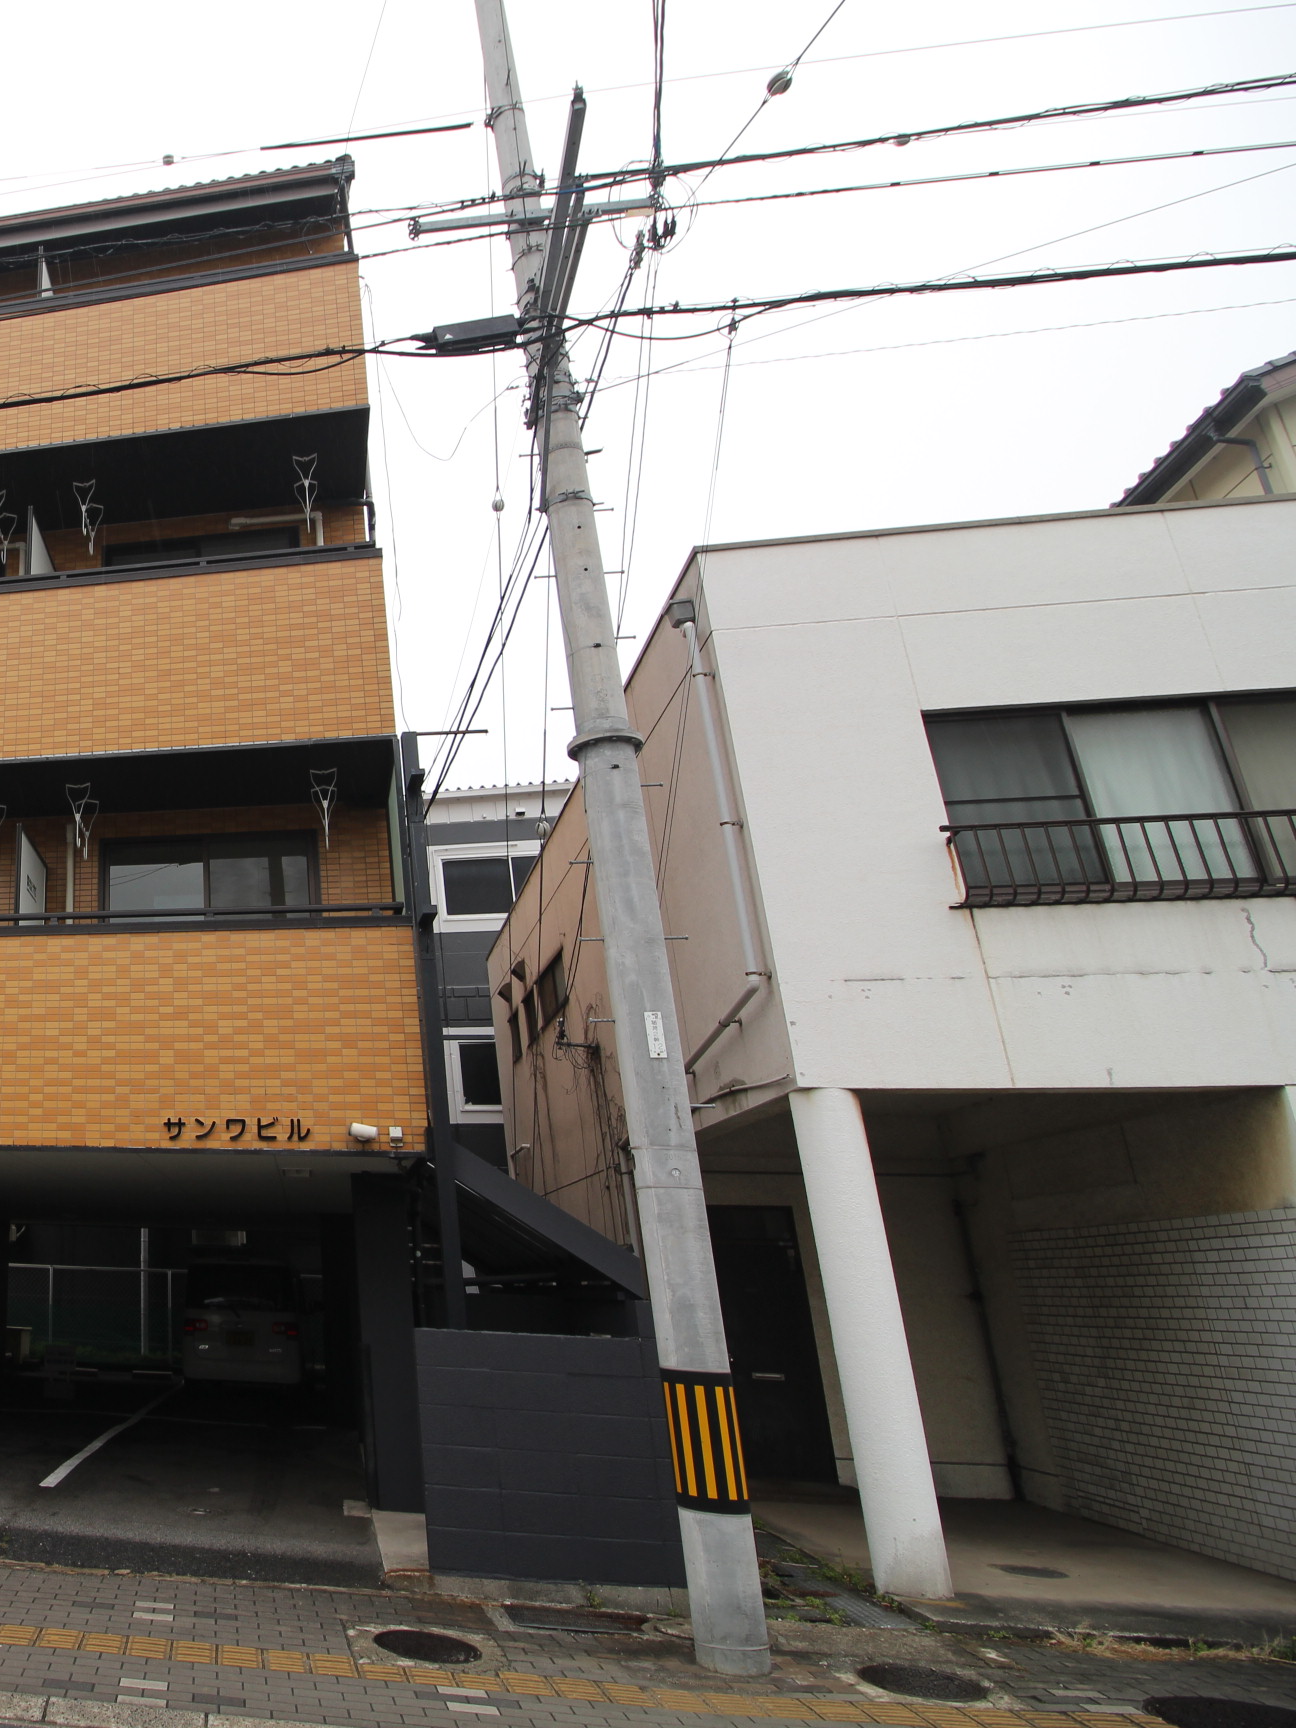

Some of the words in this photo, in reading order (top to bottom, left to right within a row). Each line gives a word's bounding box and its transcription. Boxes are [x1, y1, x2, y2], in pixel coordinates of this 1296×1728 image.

[163, 1117, 311, 1142] サンワビル
